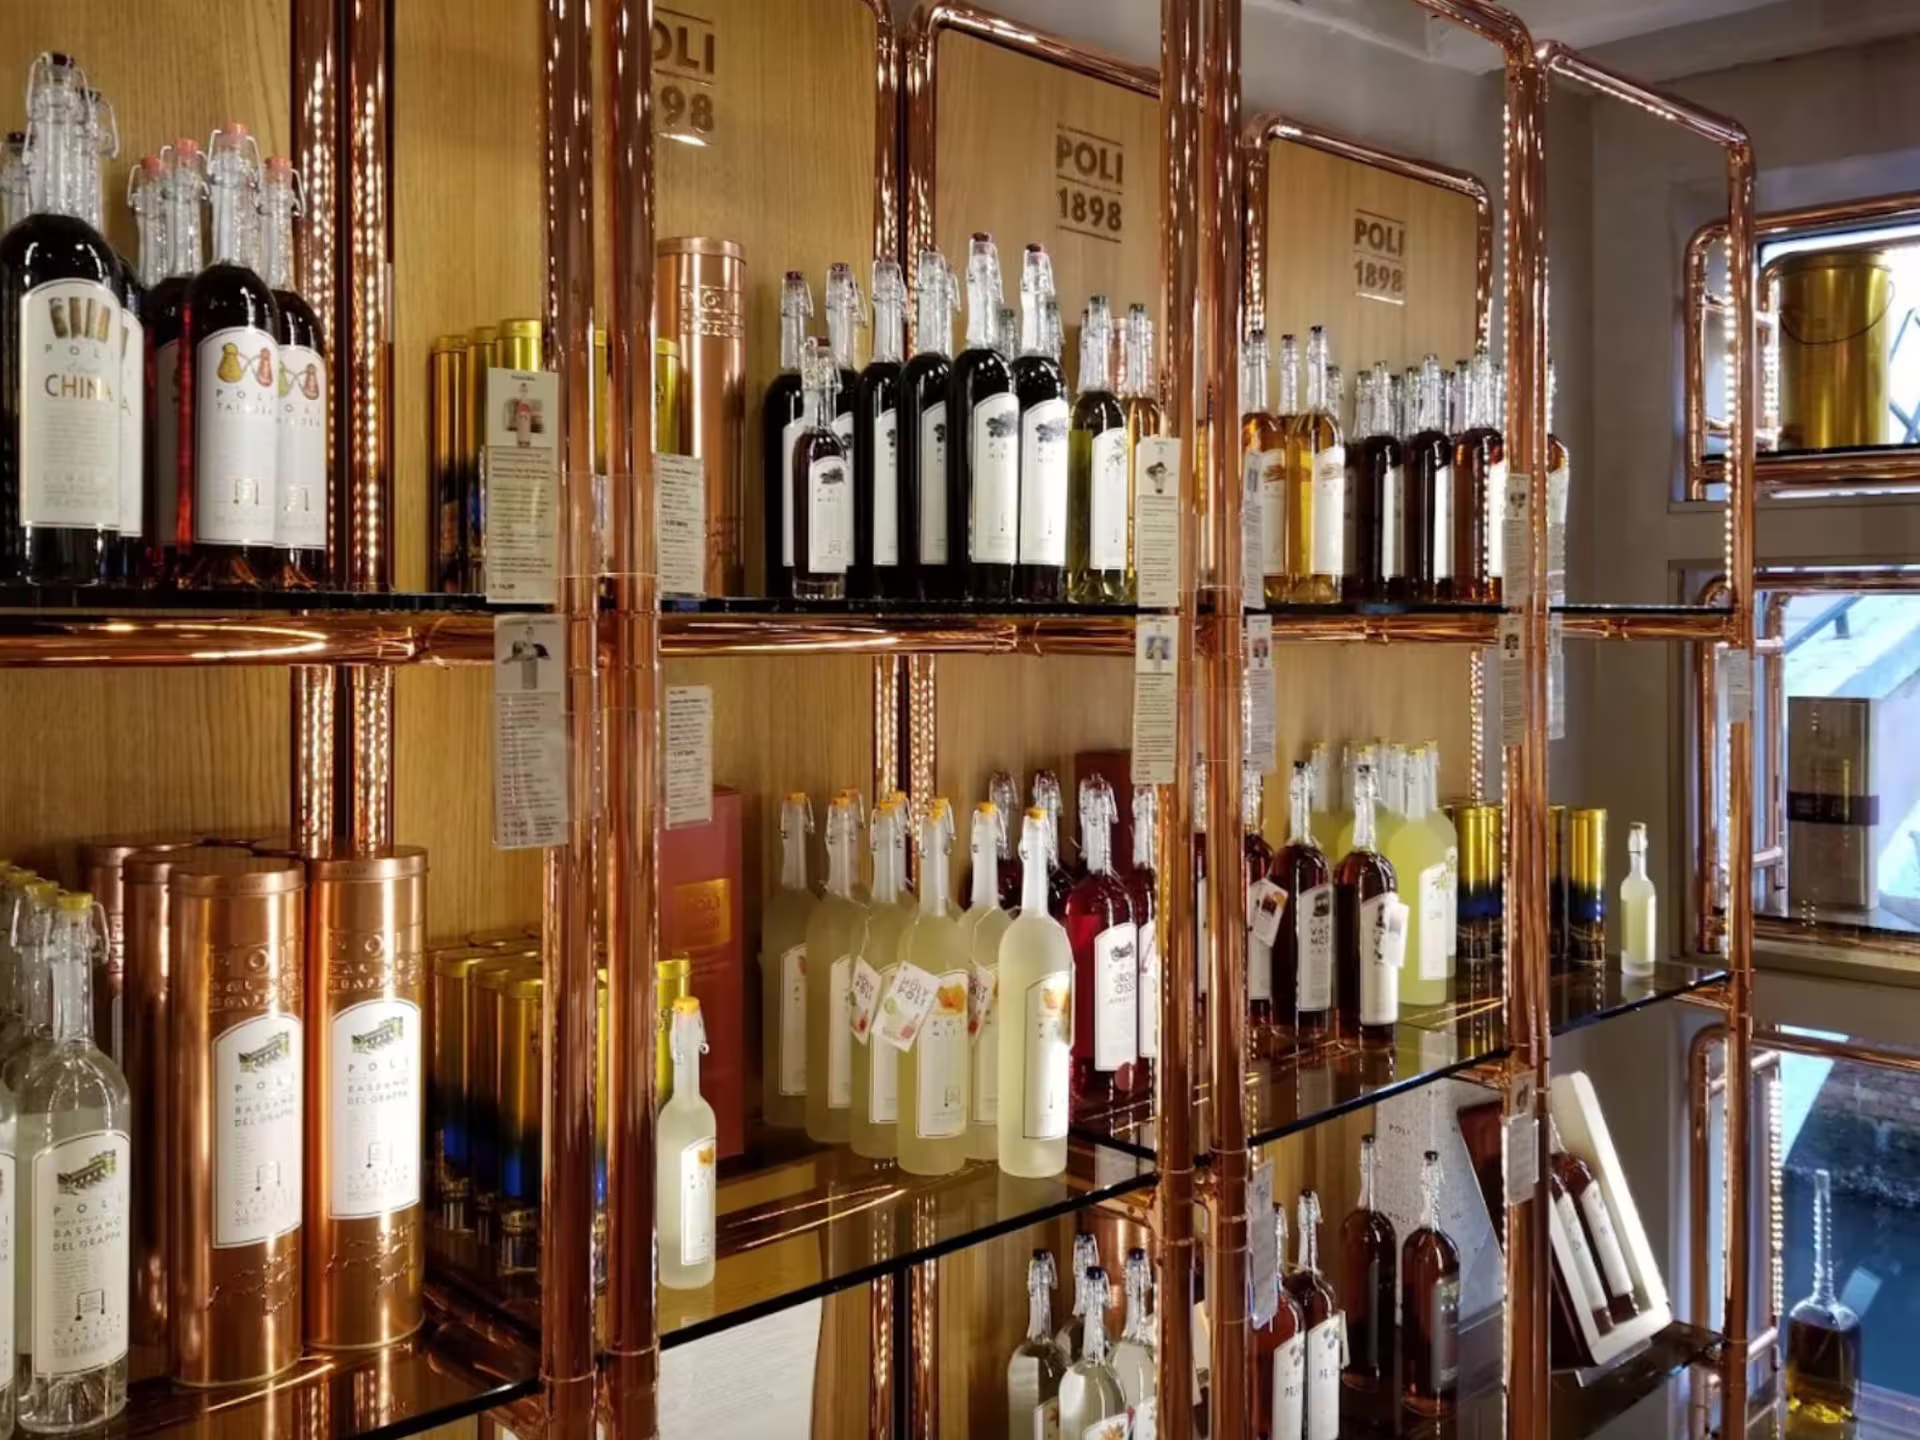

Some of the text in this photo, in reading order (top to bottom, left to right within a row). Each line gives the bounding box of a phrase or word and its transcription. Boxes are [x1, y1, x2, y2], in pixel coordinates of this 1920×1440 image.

[655, 20, 715, 75] OLI
[661, 85, 714, 132] 98
[1056, 134, 1123, 185] POLI
[1057, 187, 1122, 232] 1898
[1355, 218, 1405, 257] POLI
[1354, 260, 1403, 293] 1898
[44, 344, 115, 359] POLI
[216, 388, 273, 402] POLI
[897, 987, 926, 1007] POLI
[900, 976, 929, 996] HOLY
[53, 1192, 122, 1217] POLI
[53, 1216, 122, 1240] BASSANO
[53, 1241, 76, 1253] DEL
